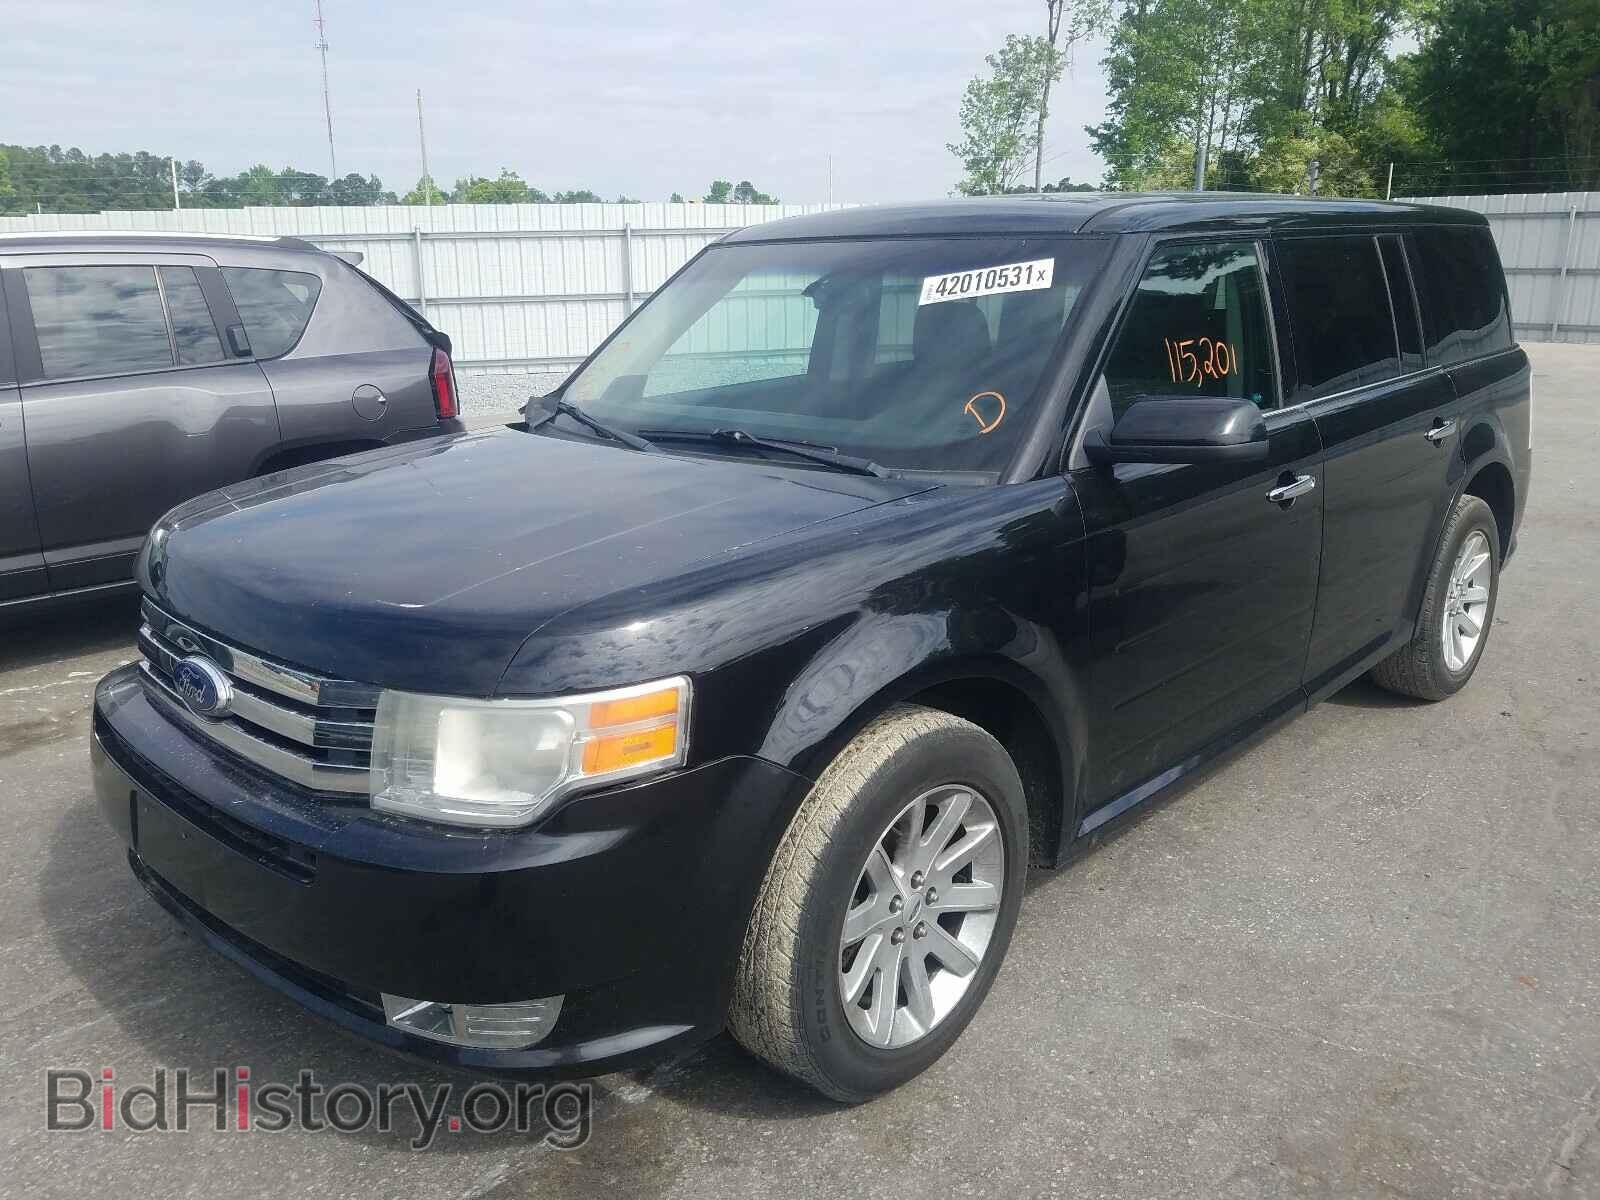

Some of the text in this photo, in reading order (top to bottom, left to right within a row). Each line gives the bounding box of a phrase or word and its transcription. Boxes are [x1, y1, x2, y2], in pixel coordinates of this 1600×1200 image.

[935, 265, 1033, 296] 42010531
[1165, 337, 1238, 388] 115,201
[964, 391, 1007, 435] D
